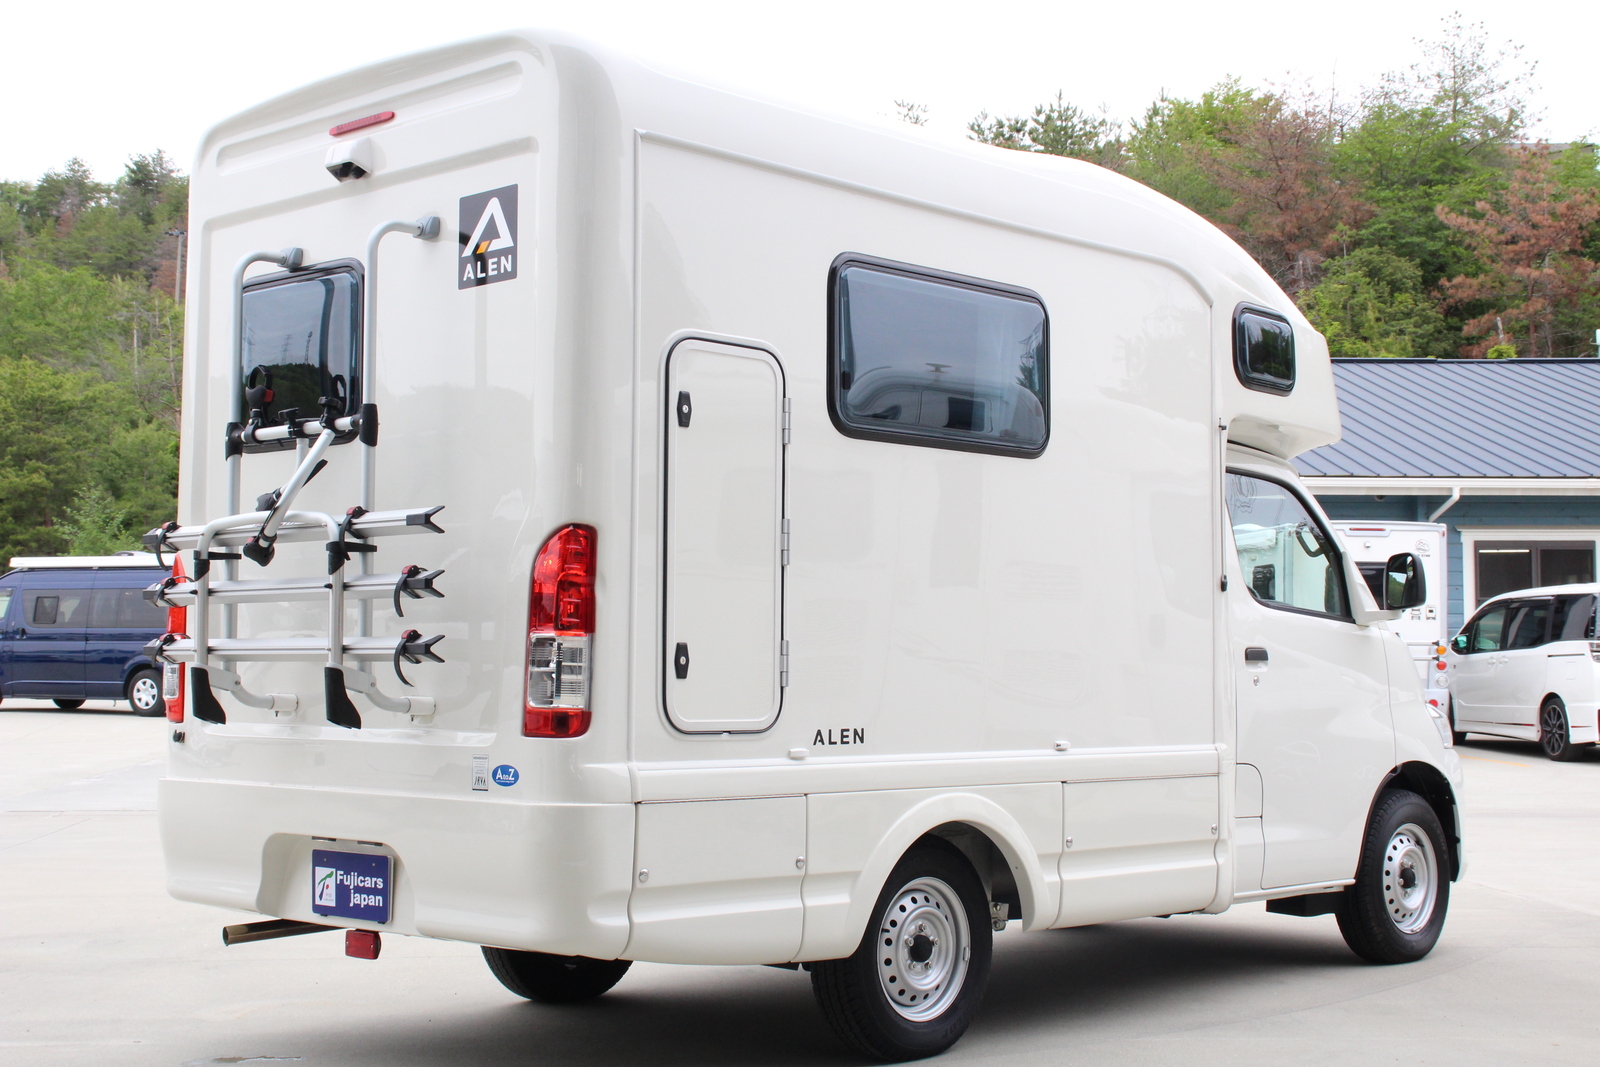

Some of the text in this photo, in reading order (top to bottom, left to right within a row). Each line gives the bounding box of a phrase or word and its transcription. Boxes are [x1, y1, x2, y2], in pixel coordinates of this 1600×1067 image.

[463, 254, 512, 281] ALEN
[813, 728, 864, 746] ALEN
[336, 870, 384, 889] Fujicars
[349, 889, 383, 908] japan
